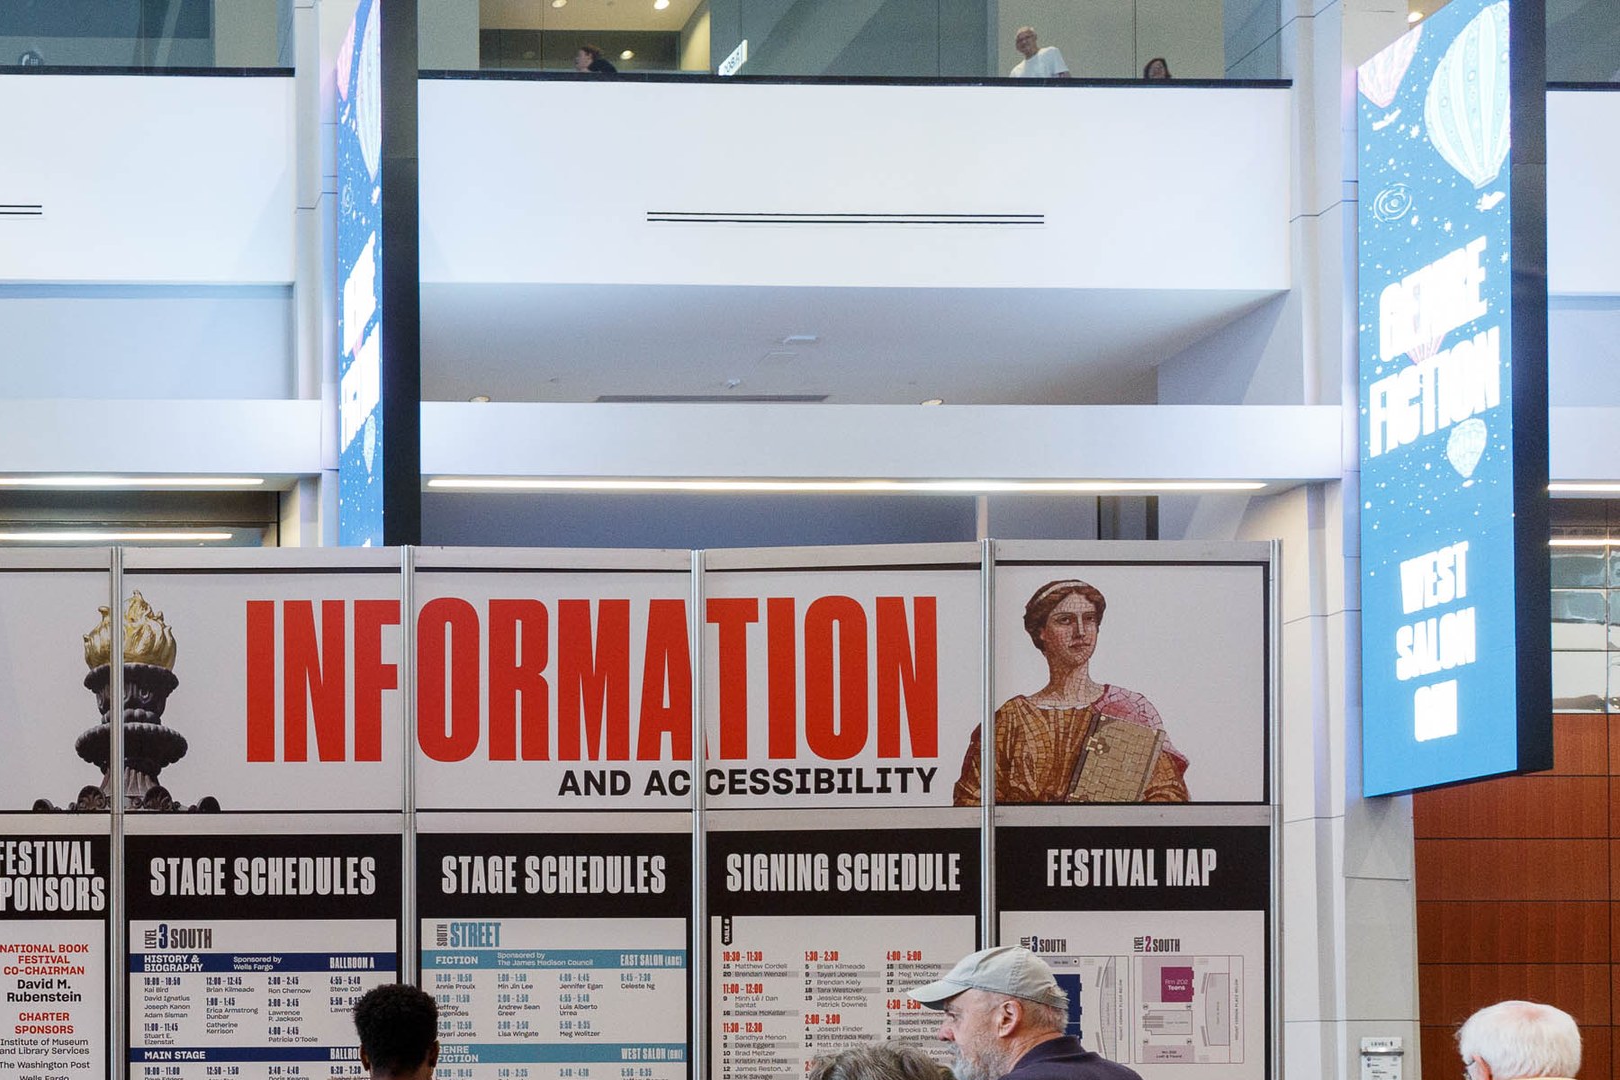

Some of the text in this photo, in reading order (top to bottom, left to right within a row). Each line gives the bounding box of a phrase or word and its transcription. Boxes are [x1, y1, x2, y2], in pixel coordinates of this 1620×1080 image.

[1370, 326, 1500, 458] FICTION
[1400, 541, 1469, 615] WEST
[1396, 607, 1476, 681] SALON
[246, 597, 938, 762] INFORMATION
[558, 767, 938, 796] AND ACCESSIBILITY
[727, 854, 960, 891] SIGNING SCHEDULE
[1048, 849, 1216, 886] FESTIVAL MAP
[151, 857, 375, 895] STAGE SCHEDULES
[442, 856, 665, 894] STAGE SCHEDULES
[144, 923, 212, 949] LEVEL 3 SOUTH
[436, 922, 501, 947] SOUTH STREET
[0, 944, 88, 953] NATIONAL BOOK
[1032, 936, 1066, 952] 3 SOUTH
[1145, 935, 1152, 951] 2
[1153, 939, 1180, 952] SOUTH
[18, 955, 70, 964] FESTIVAL
[144, 953, 188, 963] HISTORY
[234, 956, 271, 965] Sponsored
[330, 957, 374, 968] BALLROOM A
[436, 956, 478, 964] FICTION
[621, 955, 663, 968] EAST SALON
[4, 966, 84, 975] CO-CHAIRMAN
[144, 964, 203, 972] BIOGRAPHY
[18, 978, 70, 989] David M.
[7, 991, 81, 1002] Rubenstein
[19, 1013, 69, 1021] CHARTER
[15, 1025, 73, 1034] SPONSORS
[1, 1038, 38, 1046] Institute
[19, 1047, 49, 1056] Library
[175, 1051, 205, 1059] STAGE
[18, 1061, 68, 1070] Washington
